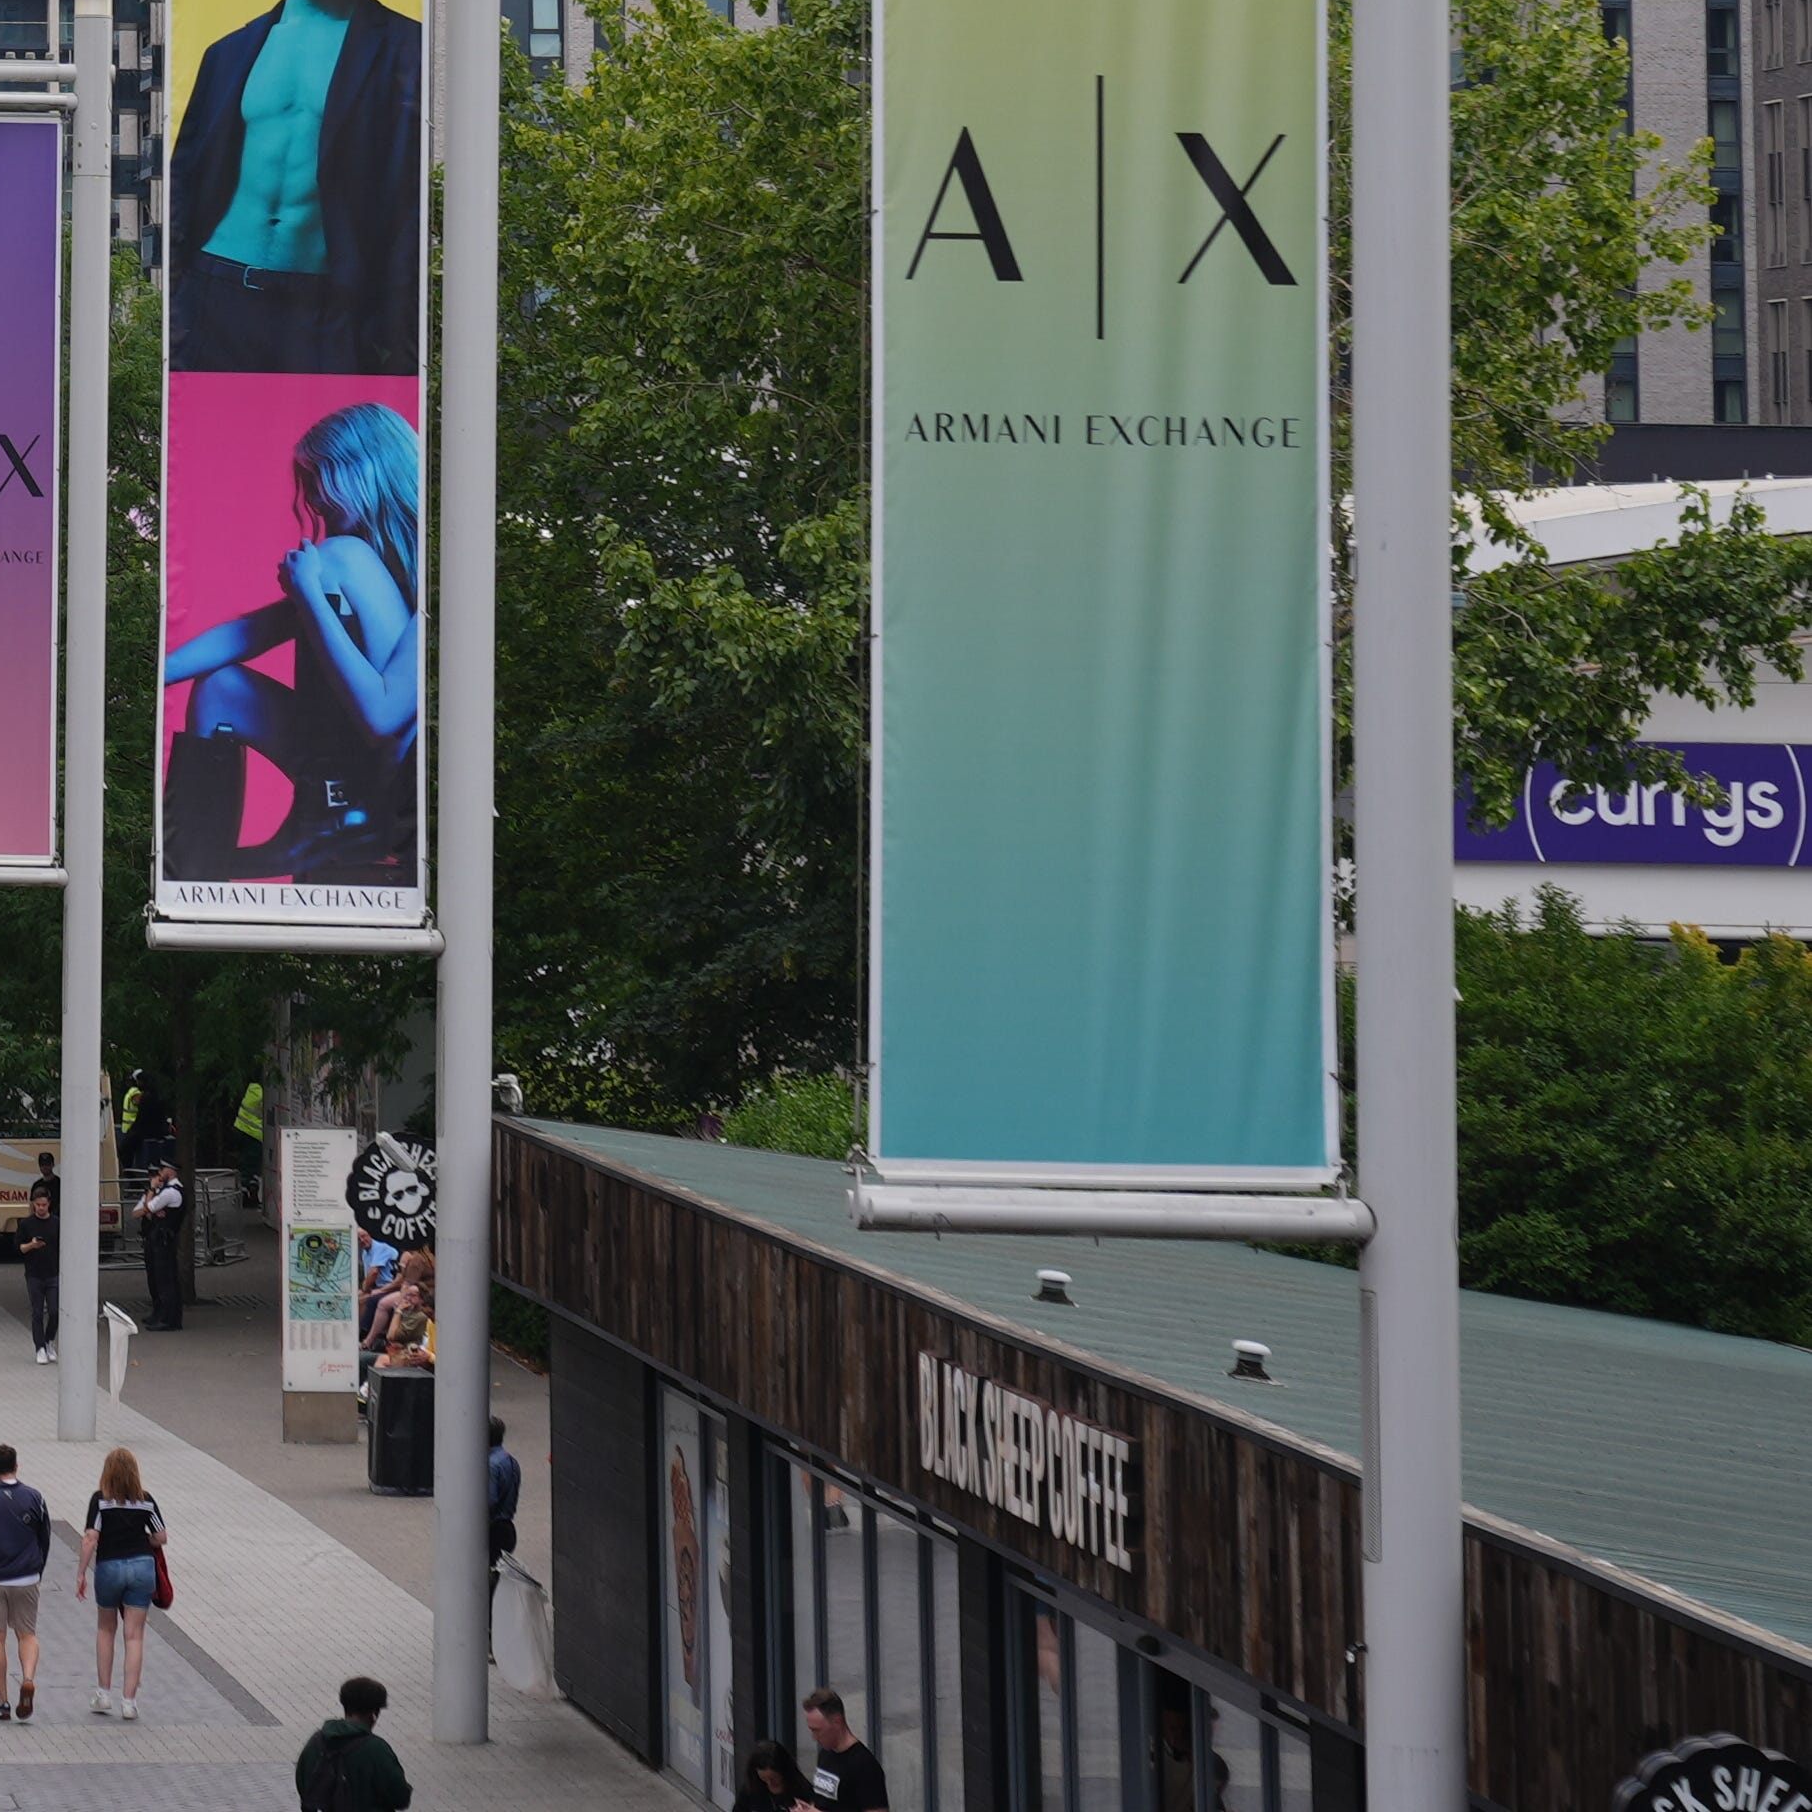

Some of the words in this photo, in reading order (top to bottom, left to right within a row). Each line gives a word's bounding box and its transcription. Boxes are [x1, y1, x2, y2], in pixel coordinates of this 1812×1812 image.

[904, 412, 1061, 445] ARMANI
[1085, 414, 1301, 449] EXCHANGE
[174, 886, 266, 905] ARMANI
[280, 889, 406, 910] EXCHANGE
[919, 1351, 982, 1499] BLACK
[983, 1379, 1045, 1528] SHEEP
[1047, 1408, 1132, 1573] COFFEE
